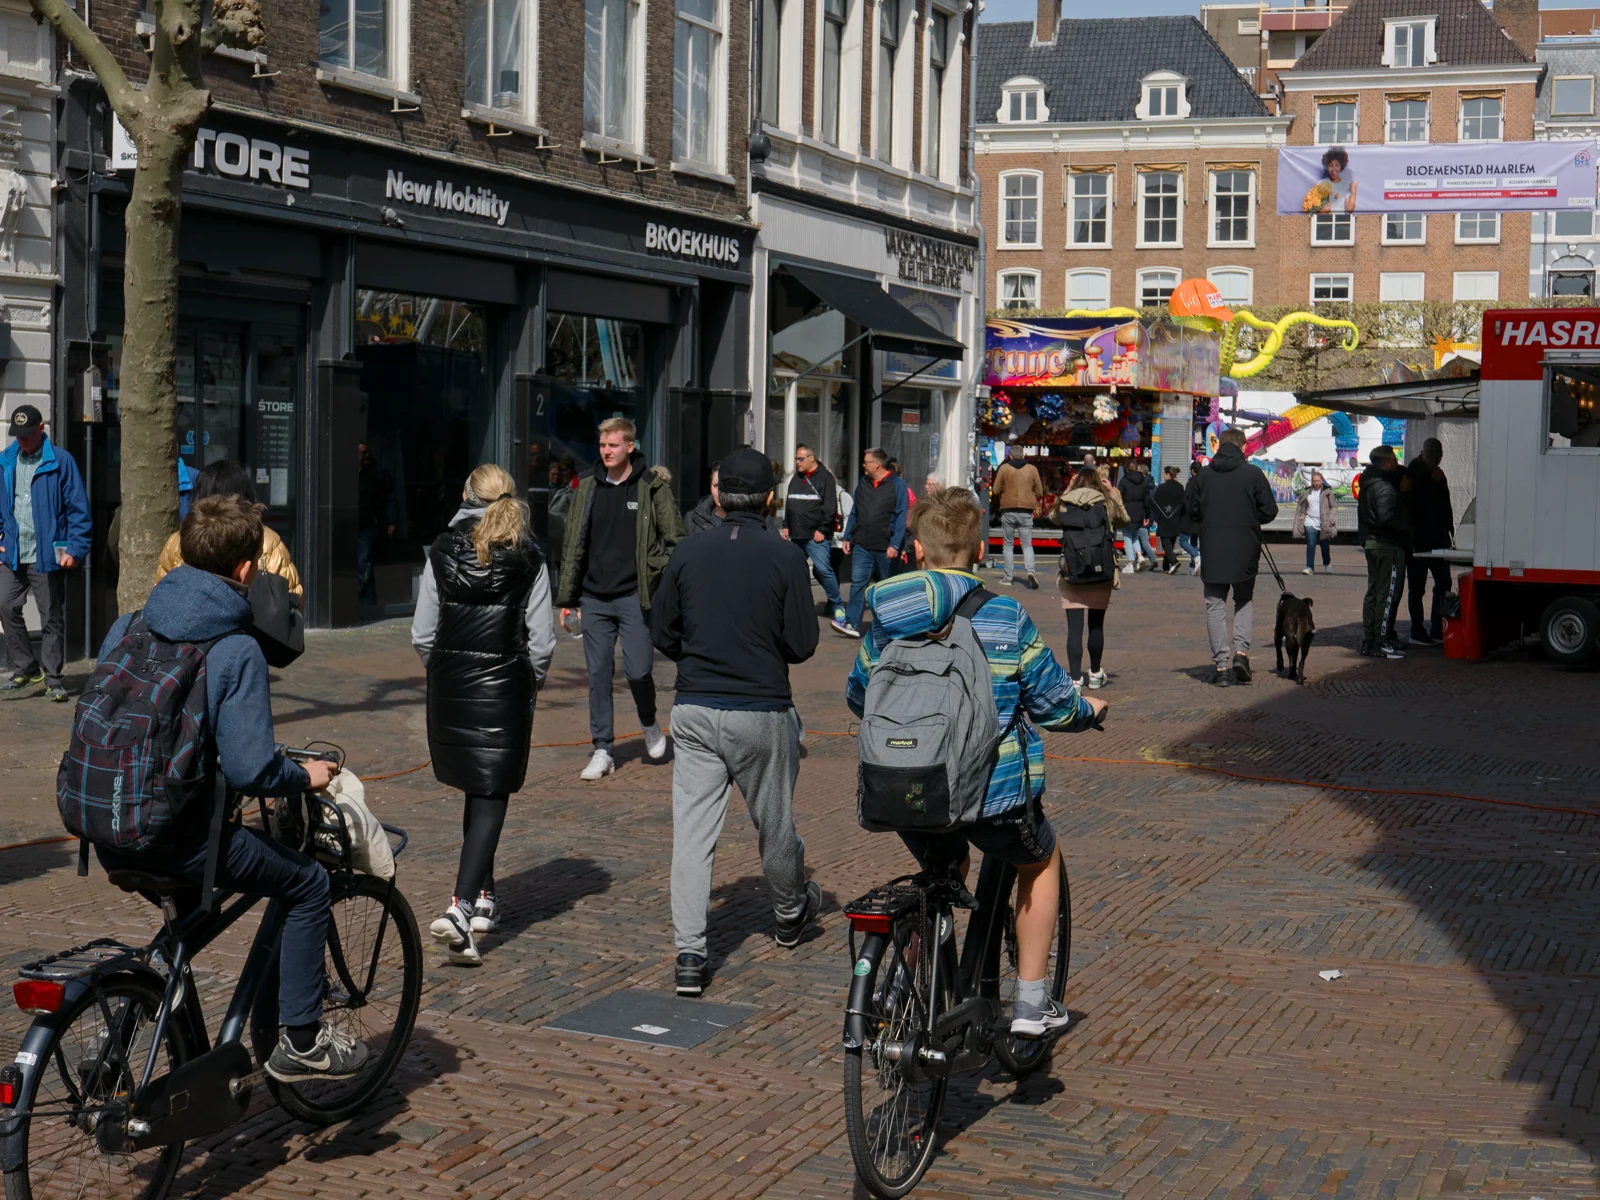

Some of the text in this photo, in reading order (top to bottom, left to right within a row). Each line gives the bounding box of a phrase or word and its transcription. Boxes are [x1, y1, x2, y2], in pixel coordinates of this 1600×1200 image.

[121, 151, 138, 161] ŠKO
[194, 128, 310, 188] TORE
[1406, 163, 1536, 176] BLOEMENSTAD HAARLEM
[386, 169, 510, 226] New Mobility
[646, 222, 739, 263] BROEKHUIS
[1501, 320, 1600, 346] HASR
[985, 346, 1067, 378] tune
[536, 393, 544, 416] 2
[111, 774, 123, 832] DAKINE
